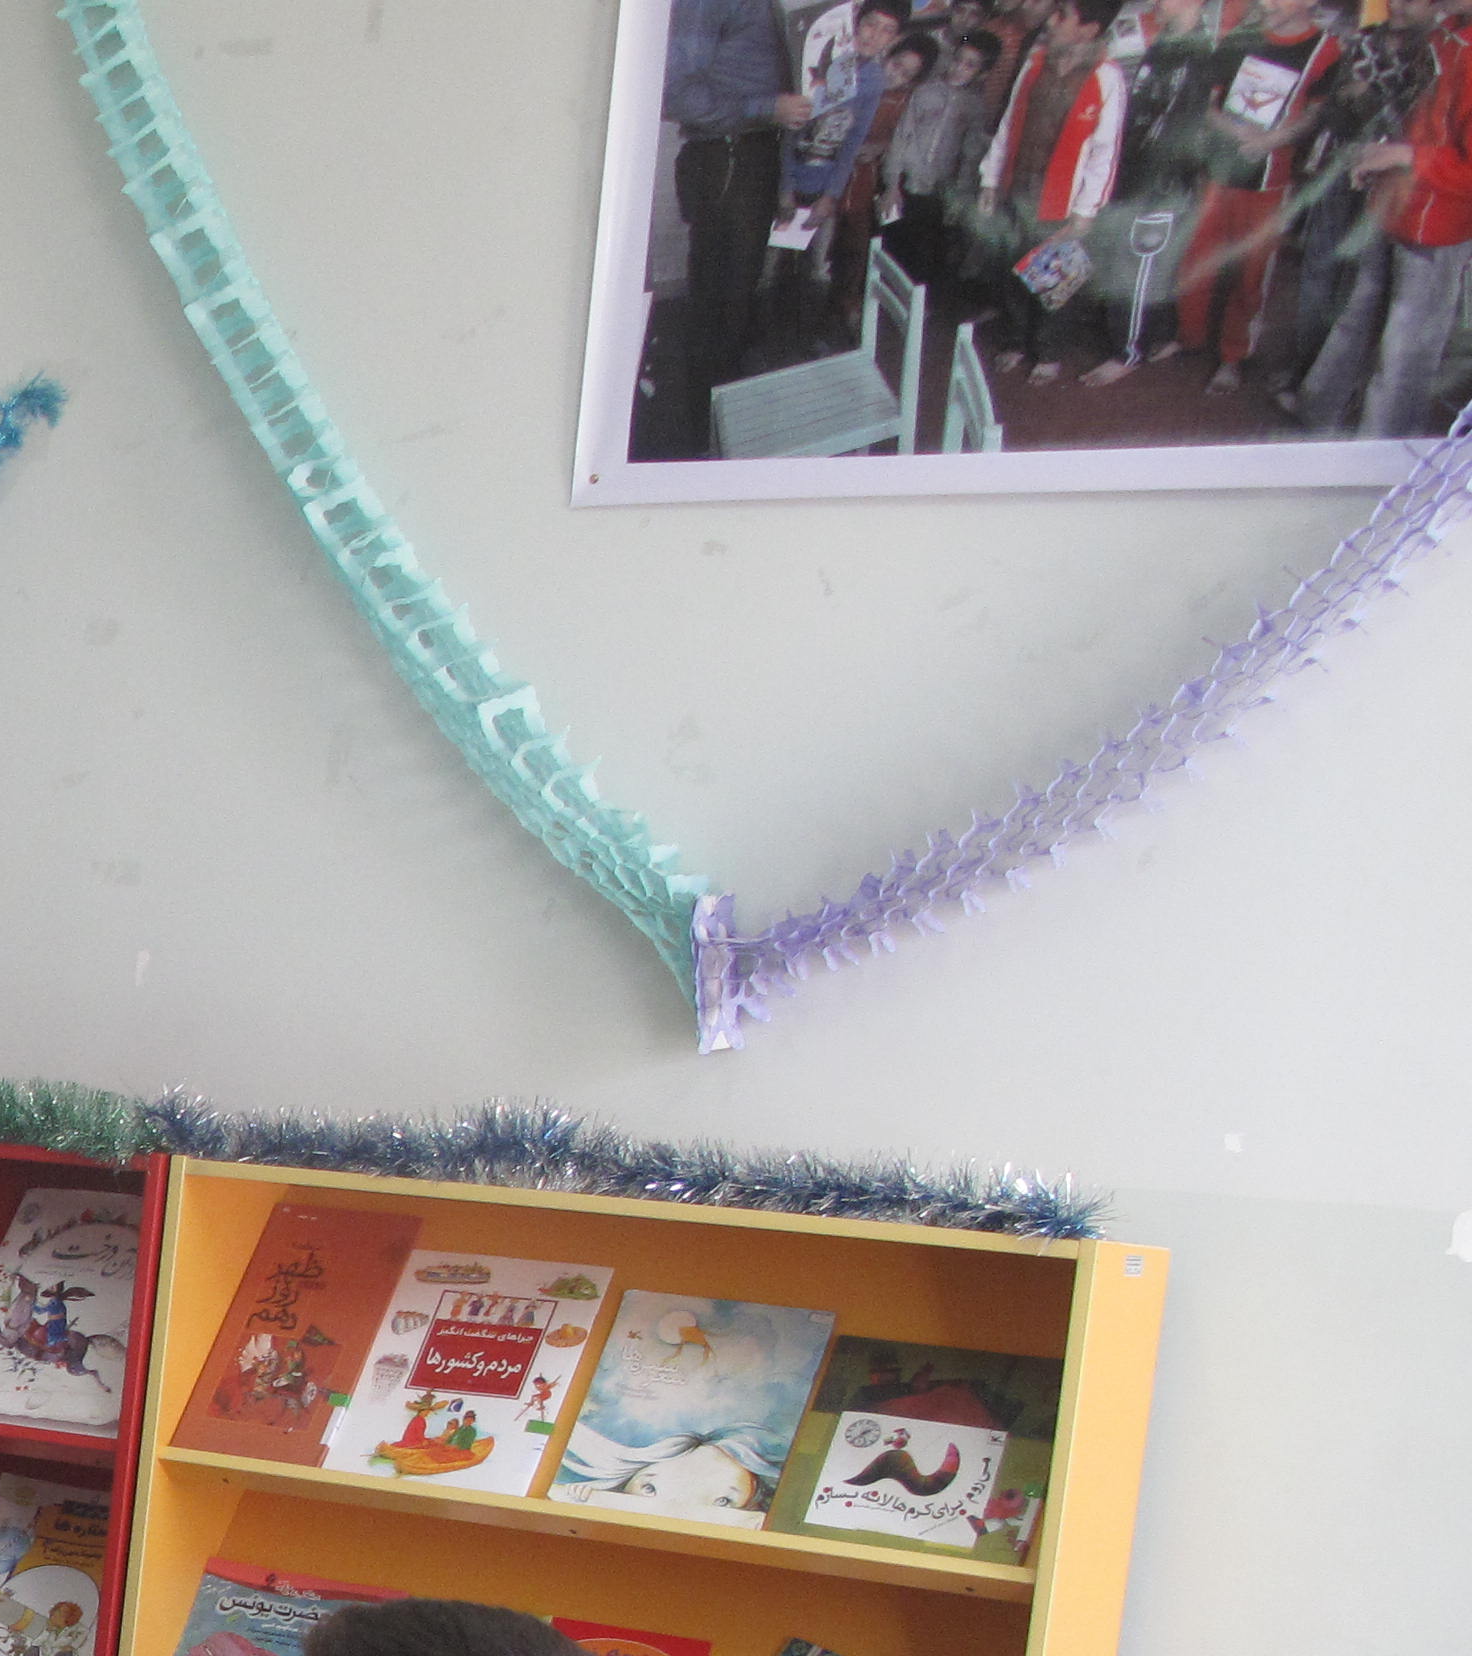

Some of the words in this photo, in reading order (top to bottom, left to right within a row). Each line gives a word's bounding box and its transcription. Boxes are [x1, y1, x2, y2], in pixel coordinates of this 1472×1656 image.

[482, 1357, 522, 1379] مردم
[814, 1486, 859, 1511] بسازم
[932, 1500, 967, 1520] برای
[219, 1594, 273, 1617] یونس
[271, 1604, 320, 1622] ضرت
